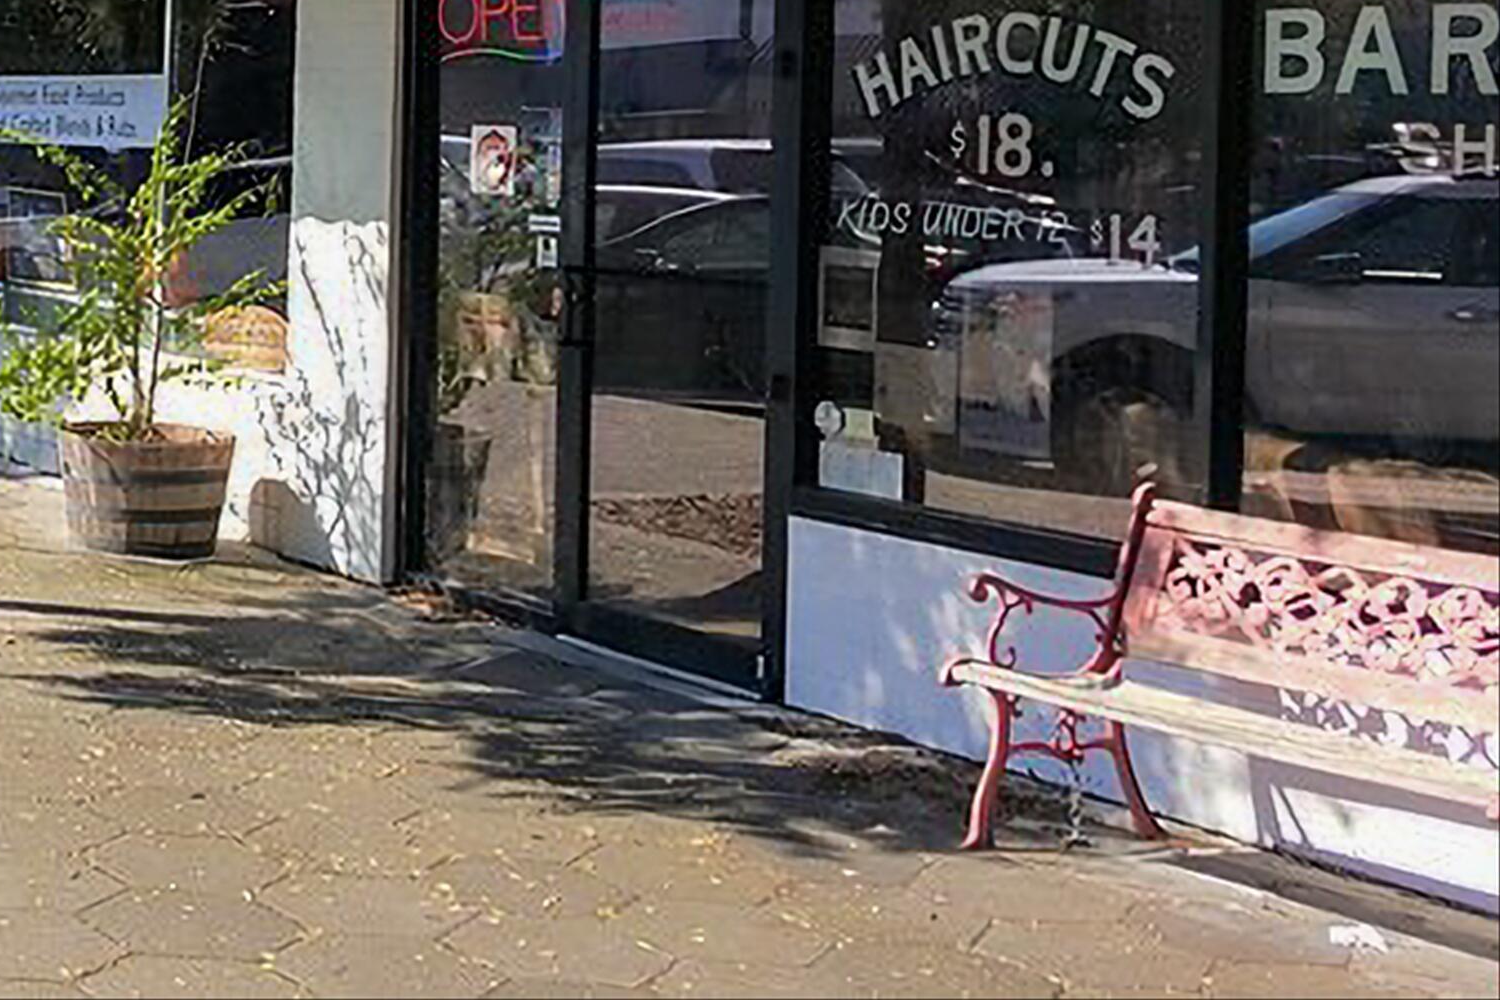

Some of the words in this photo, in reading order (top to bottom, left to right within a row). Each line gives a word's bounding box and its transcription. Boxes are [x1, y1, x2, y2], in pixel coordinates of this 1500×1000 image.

[853, 11, 1176, 120] HAIRCUTS
[1264, 2, 1499, 96] BAR
[1391, 122, 1496, 177] SH
[837, 199, 912, 234] KIDS
[922, 201, 1025, 241] UNDER
[1090, 213, 1161, 270] $14
